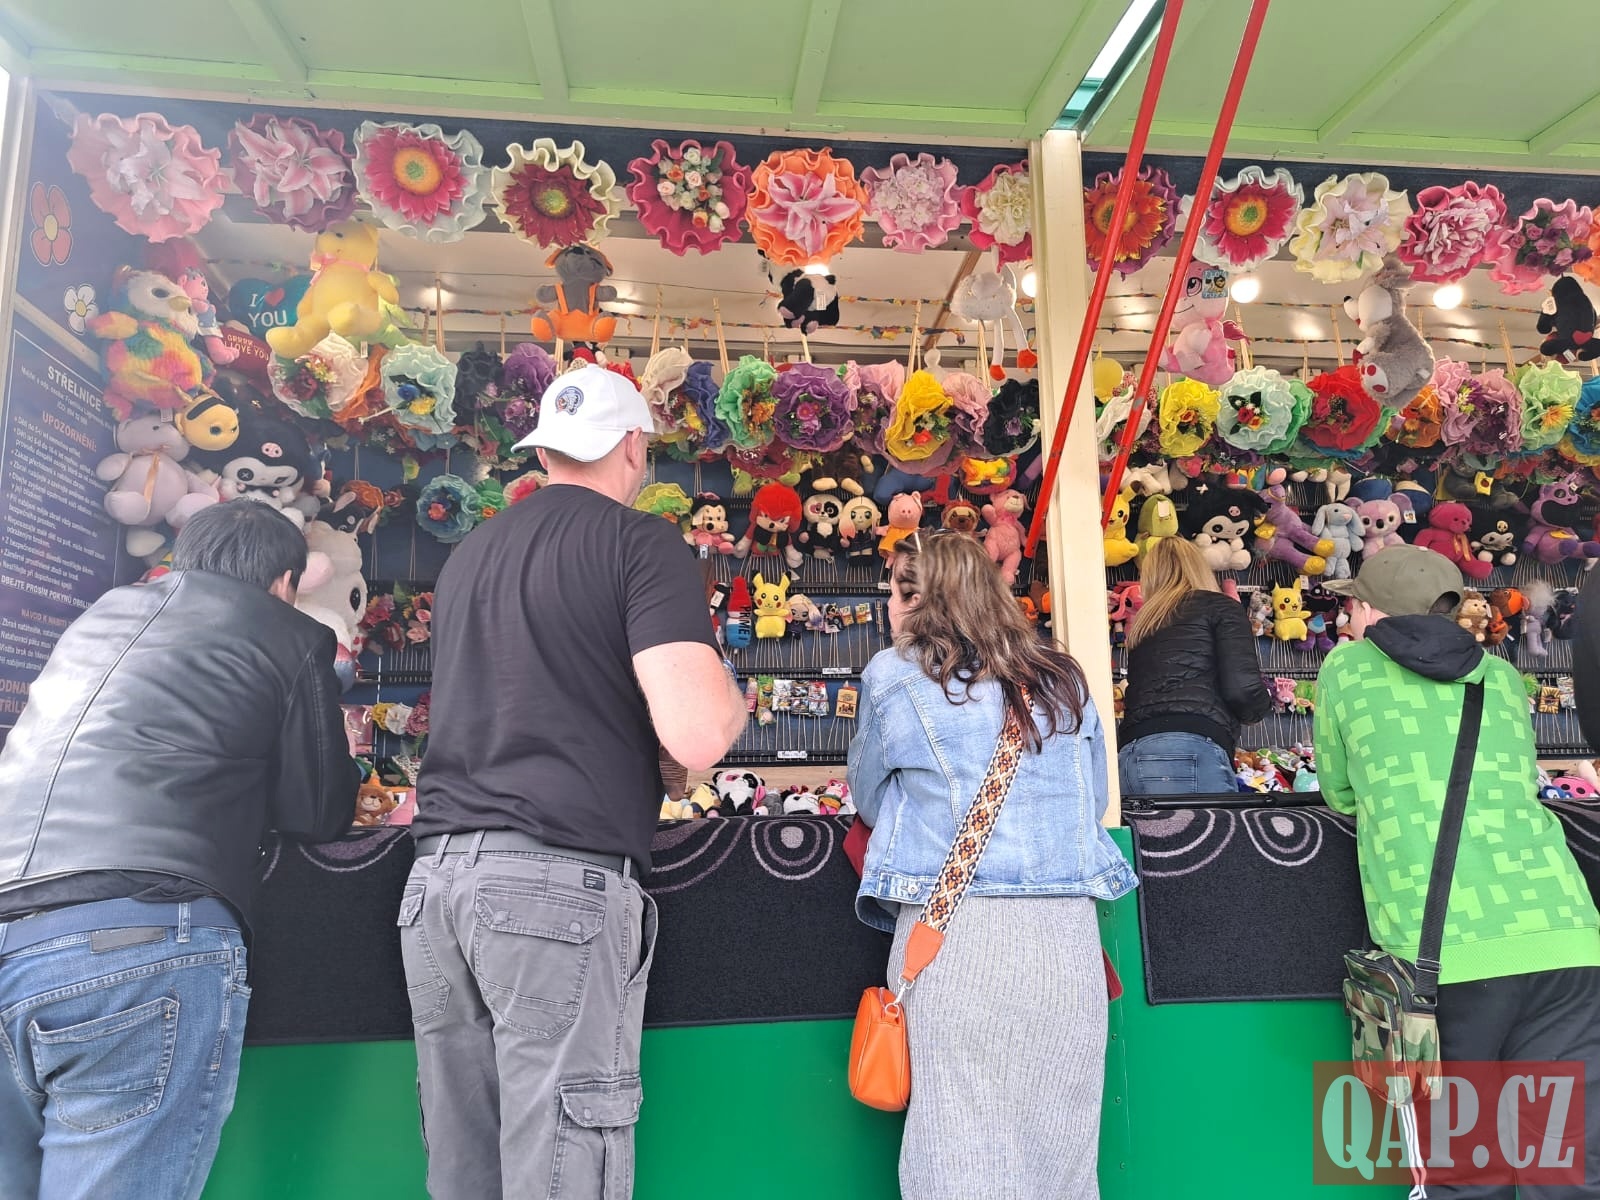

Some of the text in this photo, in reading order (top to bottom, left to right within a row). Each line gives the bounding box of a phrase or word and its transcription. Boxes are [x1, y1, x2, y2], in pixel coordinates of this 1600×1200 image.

[249, 293, 258, 307] I
[248, 309, 287, 327] YOU
[48, 366, 102, 412] STŘELNICE
[43, 411, 97, 453] UPOZORNĚNÍ:
[72, 596, 92, 610] OBSLU
